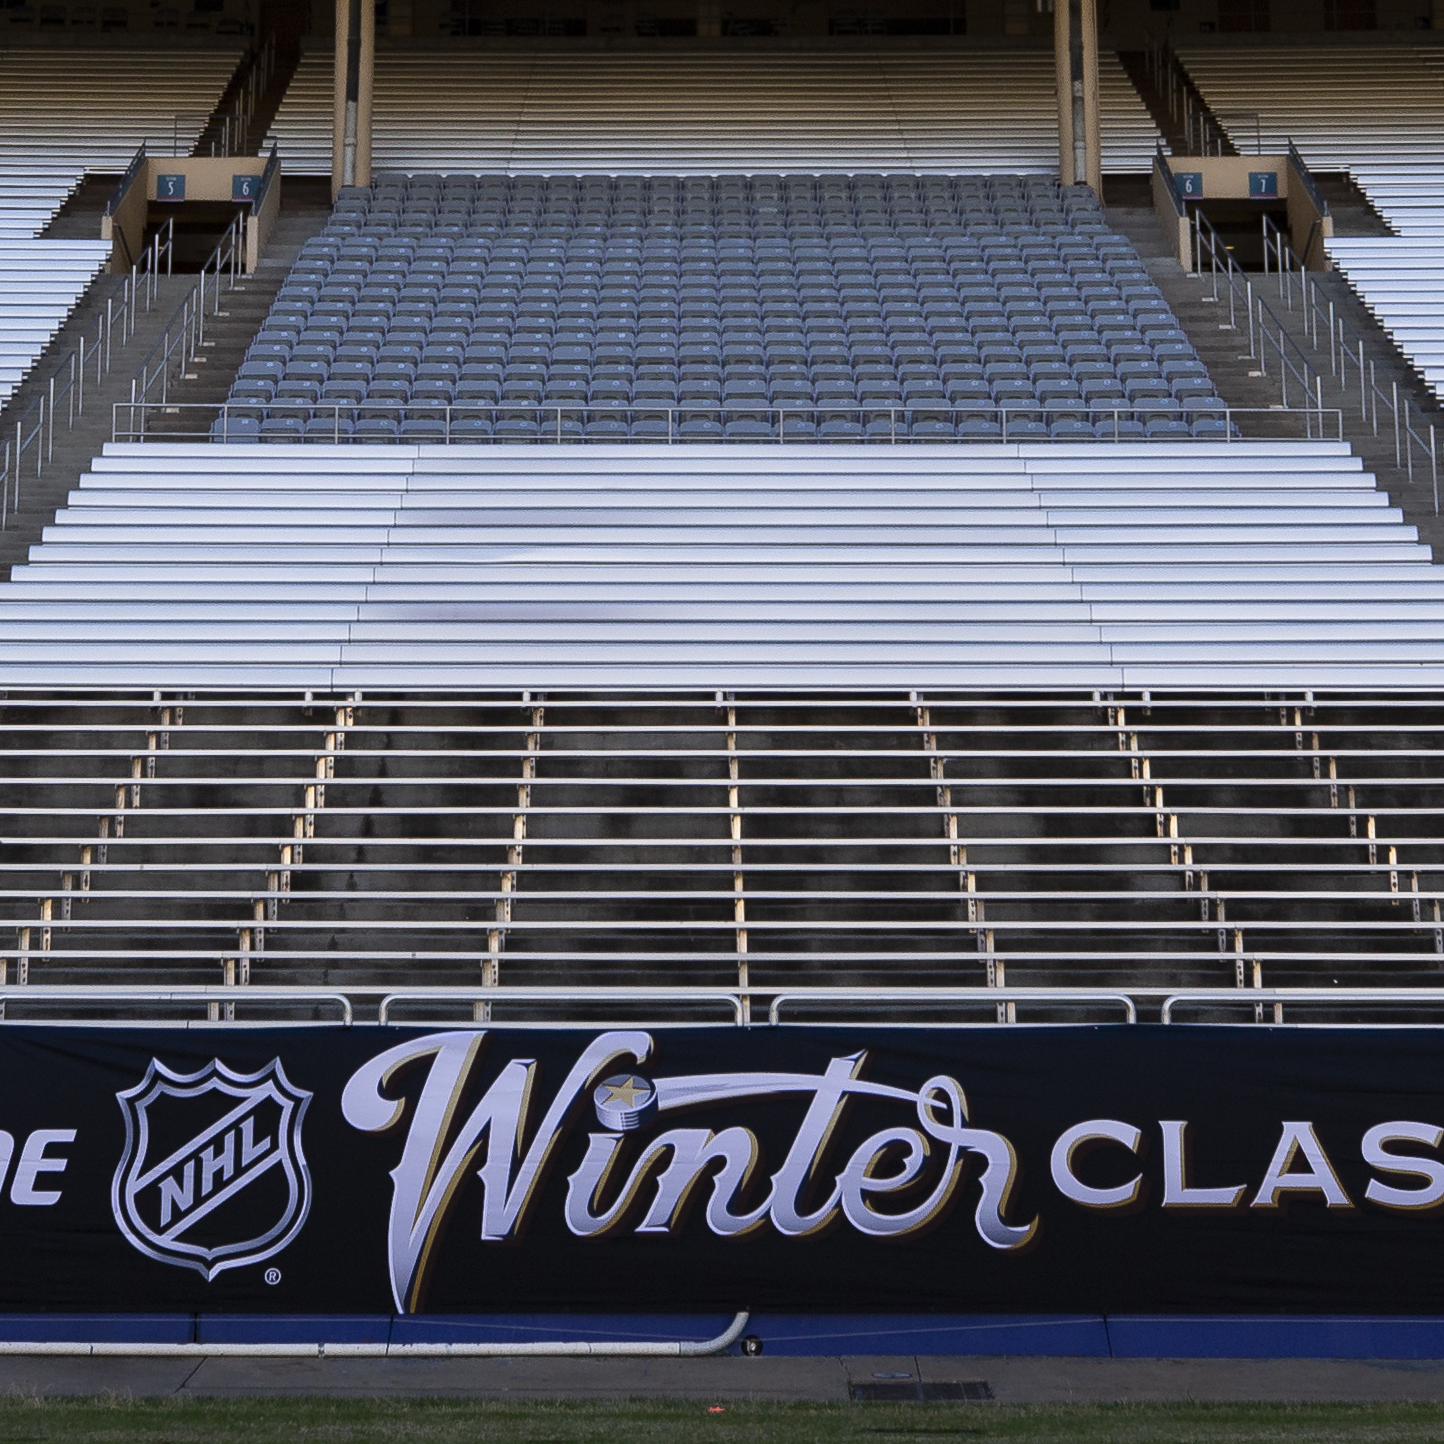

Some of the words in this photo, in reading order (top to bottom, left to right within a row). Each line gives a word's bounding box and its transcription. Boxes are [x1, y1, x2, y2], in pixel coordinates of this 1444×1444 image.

[242, 181, 250, 196] 6
[1185, 179, 1193, 193] 6
[158, 1114, 272, 1228] NHL
[341, 1029, 1040, 1315] Winter
